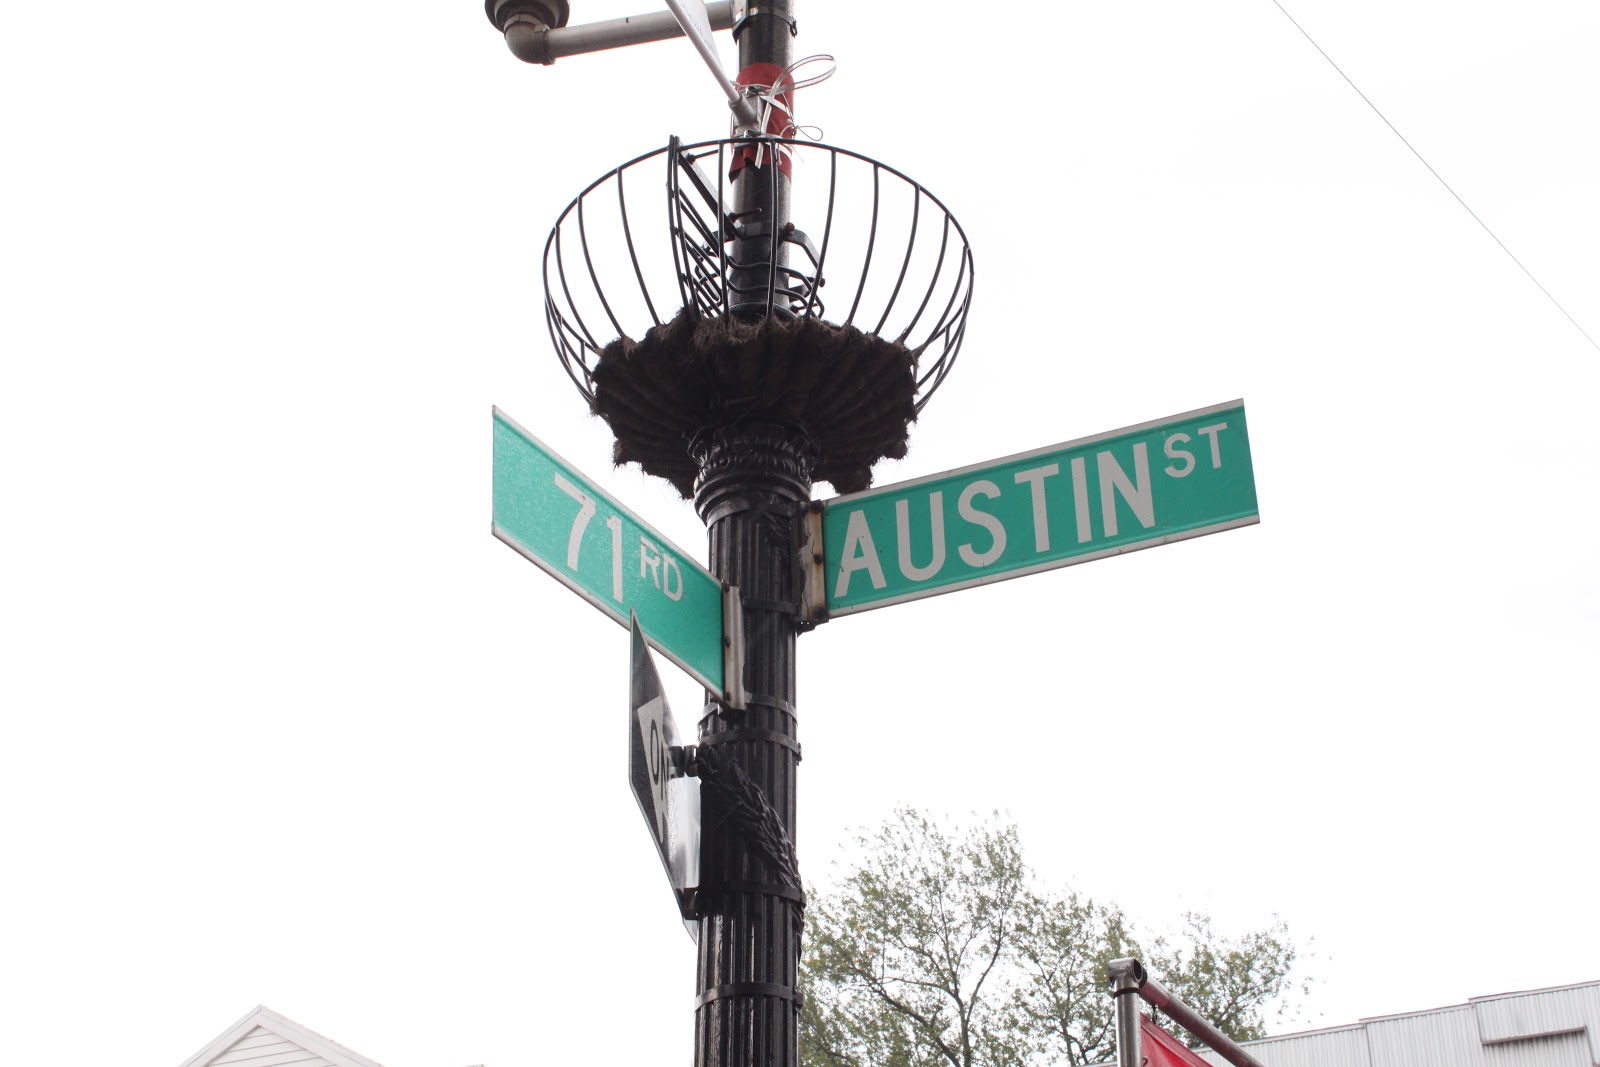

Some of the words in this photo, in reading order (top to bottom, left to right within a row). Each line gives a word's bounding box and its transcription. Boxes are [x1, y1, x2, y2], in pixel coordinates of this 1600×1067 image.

[554, 471, 623, 604] 71
[640, 535, 683, 602] RD
[833, 441, 1155, 598] AUSTIN
[1163, 422, 1227, 479] ST
